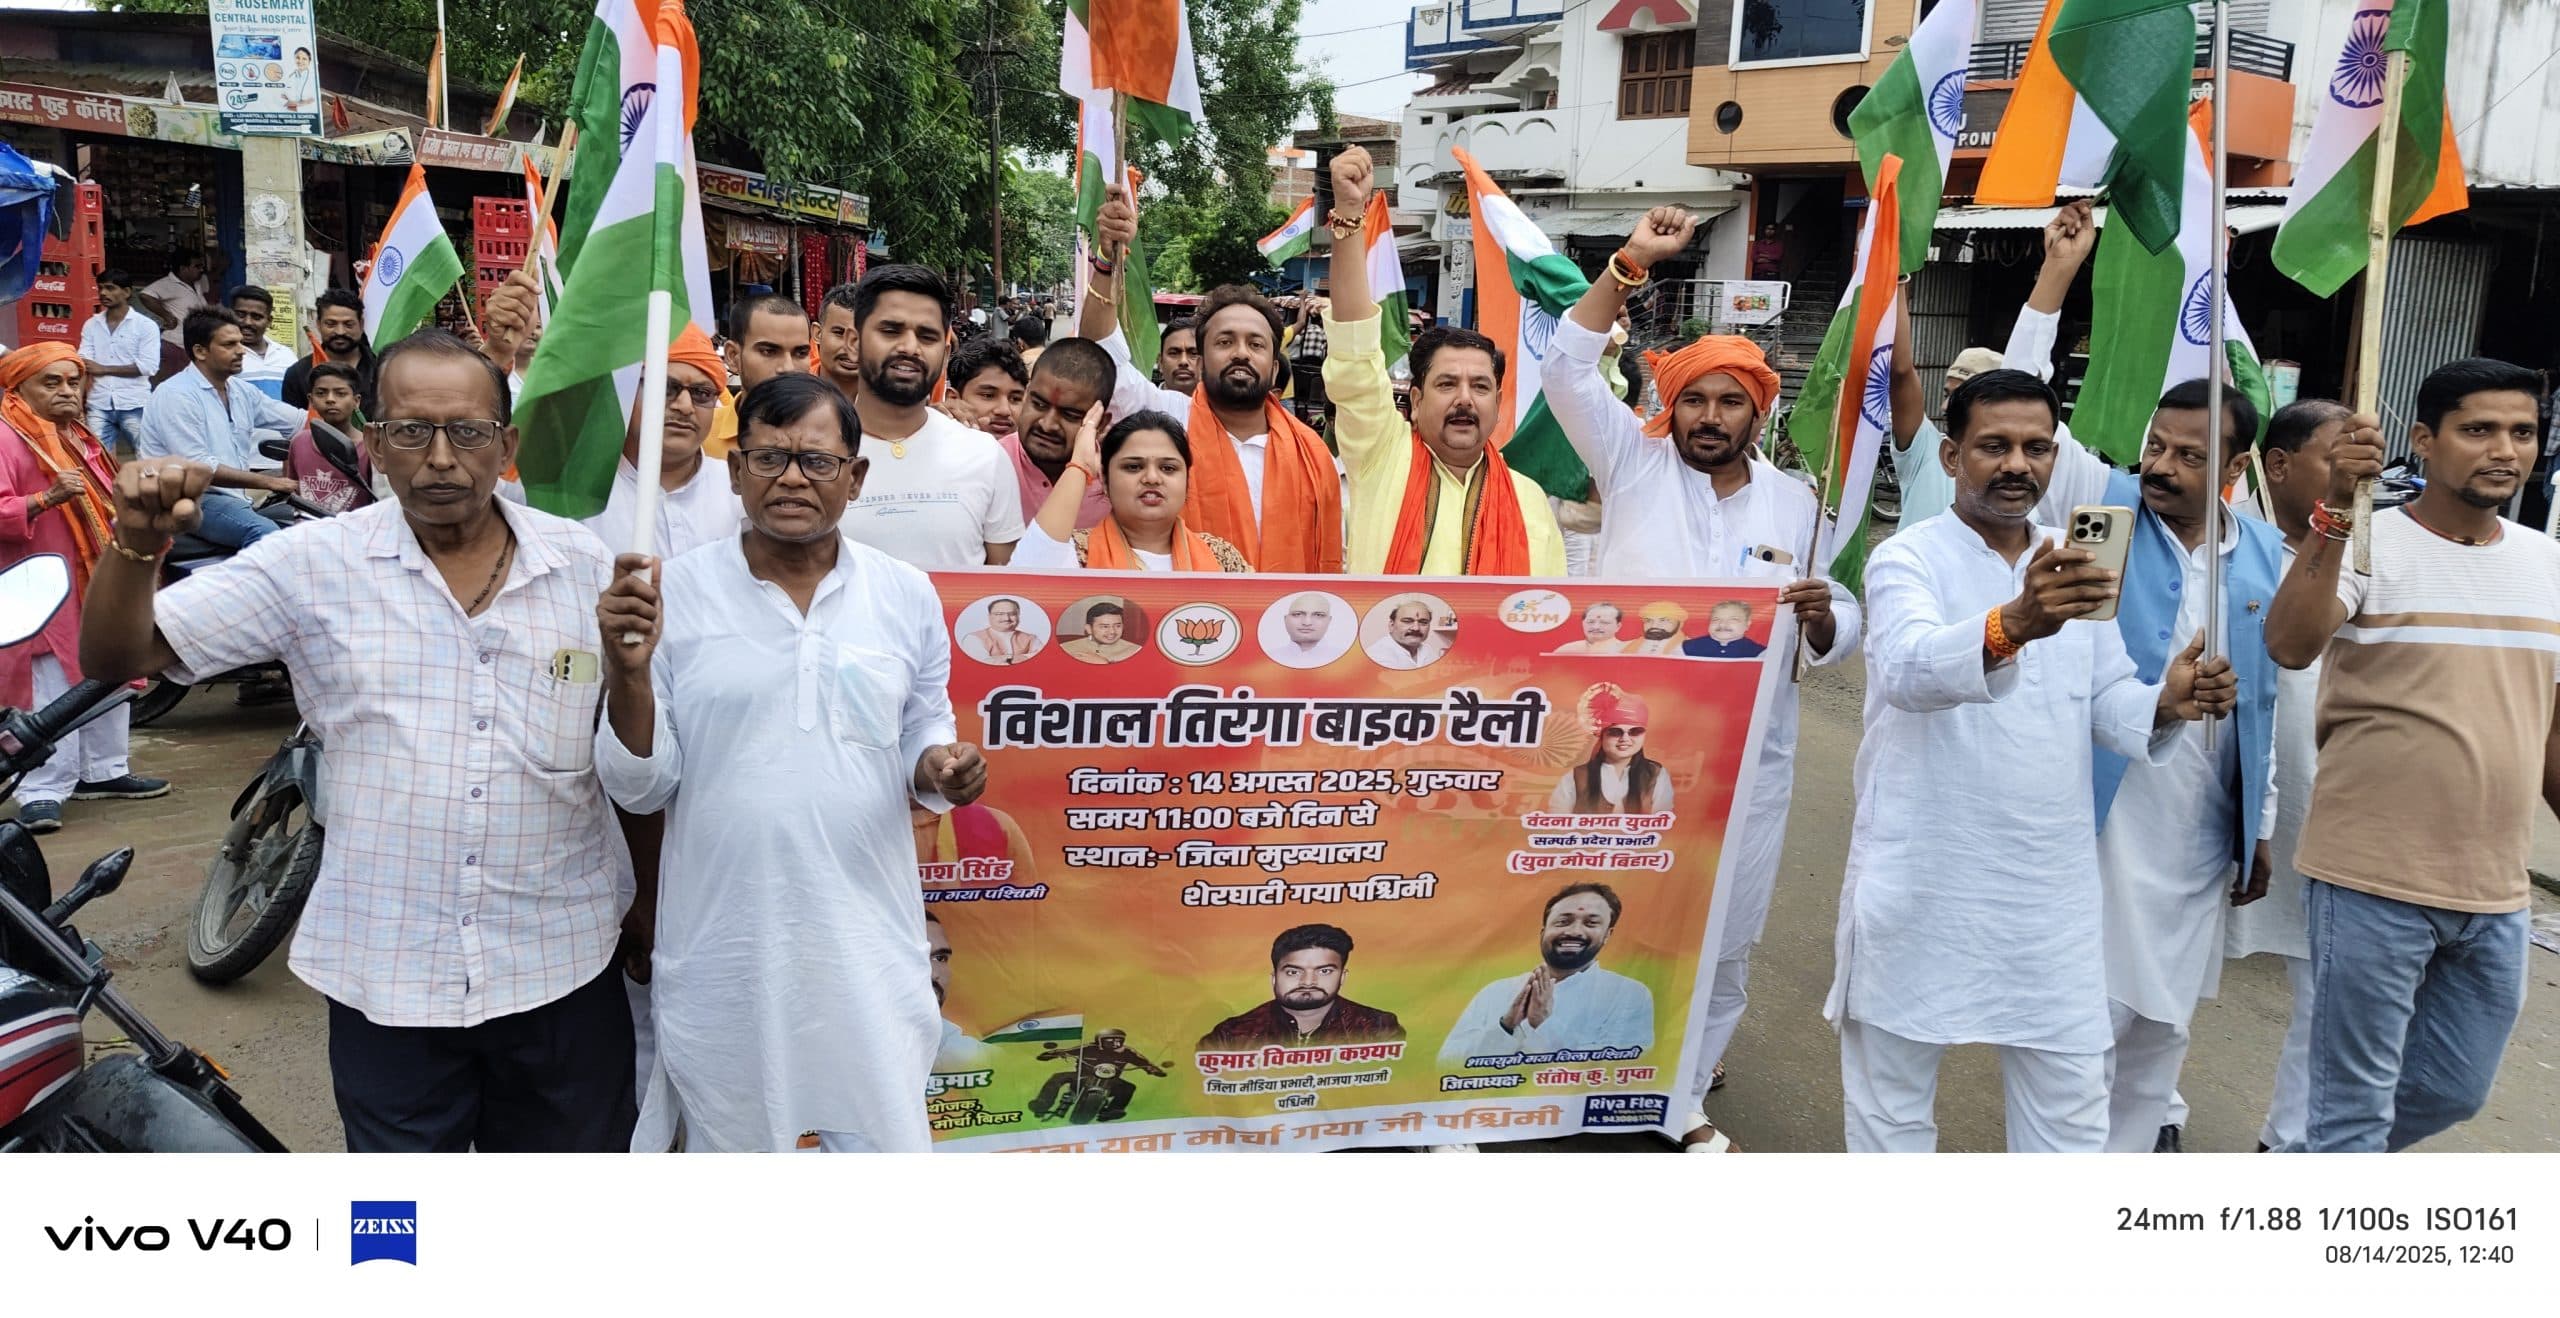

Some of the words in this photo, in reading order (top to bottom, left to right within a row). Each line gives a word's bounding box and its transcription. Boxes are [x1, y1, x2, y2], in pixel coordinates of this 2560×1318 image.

[215, 13, 258, 23] CENTRAL
[261, 15, 306, 24] HOSPITAL
[1506, 612, 1560, 624] BJYM
[984, 688, 1157, 746] विशाल
[1166, 688, 1306, 745] तिरंगा
[1314, 701, 1442, 747] बाइक
[1448, 690, 1546, 744] रैली
[1068, 767, 1167, 795] दिनांक
[1188, 771, 1224, 794] 14
[1230, 770, 1317, 793] अगस्त
[1320, 769, 1402, 794] 2025,
[1405, 769, 1503, 797] गुरुवार
[1065, 807, 1151, 830] समय
[1152, 806, 1233, 831] 11:00
[1237, 800, 1285, 829] बजे
[1290, 800, 1346, 828] दिन
[1347, 799, 1380, 827] से
[1526, 812, 1573, 828] वंदना
[1577, 815, 1622, 828] भगत
[1624, 813, 1671, 831] युवती
[1533, 835, 1578, 847] सम्पर्क
[1580, 834, 1613, 847] प्रदेश
[1615, 834, 1656, 847] प्रभारी
[1176, 839, 1253, 867] जिला
[1255, 841, 1387, 871] मुख्यालय
[1511, 853, 1556, 872] (युवा
[1559, 851, 1607, 868] मोर्चा
[1609, 852, 1671, 870] बिहार)
[960, 858, 1012, 881] सिंह
[945, 889, 979, 901] गया
[1182, 878, 1287, 906] शेरघाटी
[1289, 882, 1344, 904] गया
[1347, 872, 1439, 903] पश्चिमी
[1198, 1053, 1258, 1074] कुमार
[1264, 1047, 1335, 1068] विकाश
[1338, 1044, 1405, 1062] कश्यप
[1207, 1080, 1235, 1094] जिला
[1239, 1078, 1277, 1093] मीडिया
[1535, 1068, 1580, 1084] संतोष
[1615, 1068, 1656, 1085] गुप्ता
[928, 1100, 982, 1113] योजक,
[1629, 1097, 1665, 1109] Flex
[932, 1112, 972, 1130] मोर्चा
[975, 1112, 1021, 1126] बिहार
[1184, 1123, 1285, 1146] मोर्चा
[1291, 1119, 1368, 1141] गया
[1375, 1112, 1427, 1133] जी
[1434, 1104, 1563, 1130] पश्चिमी
